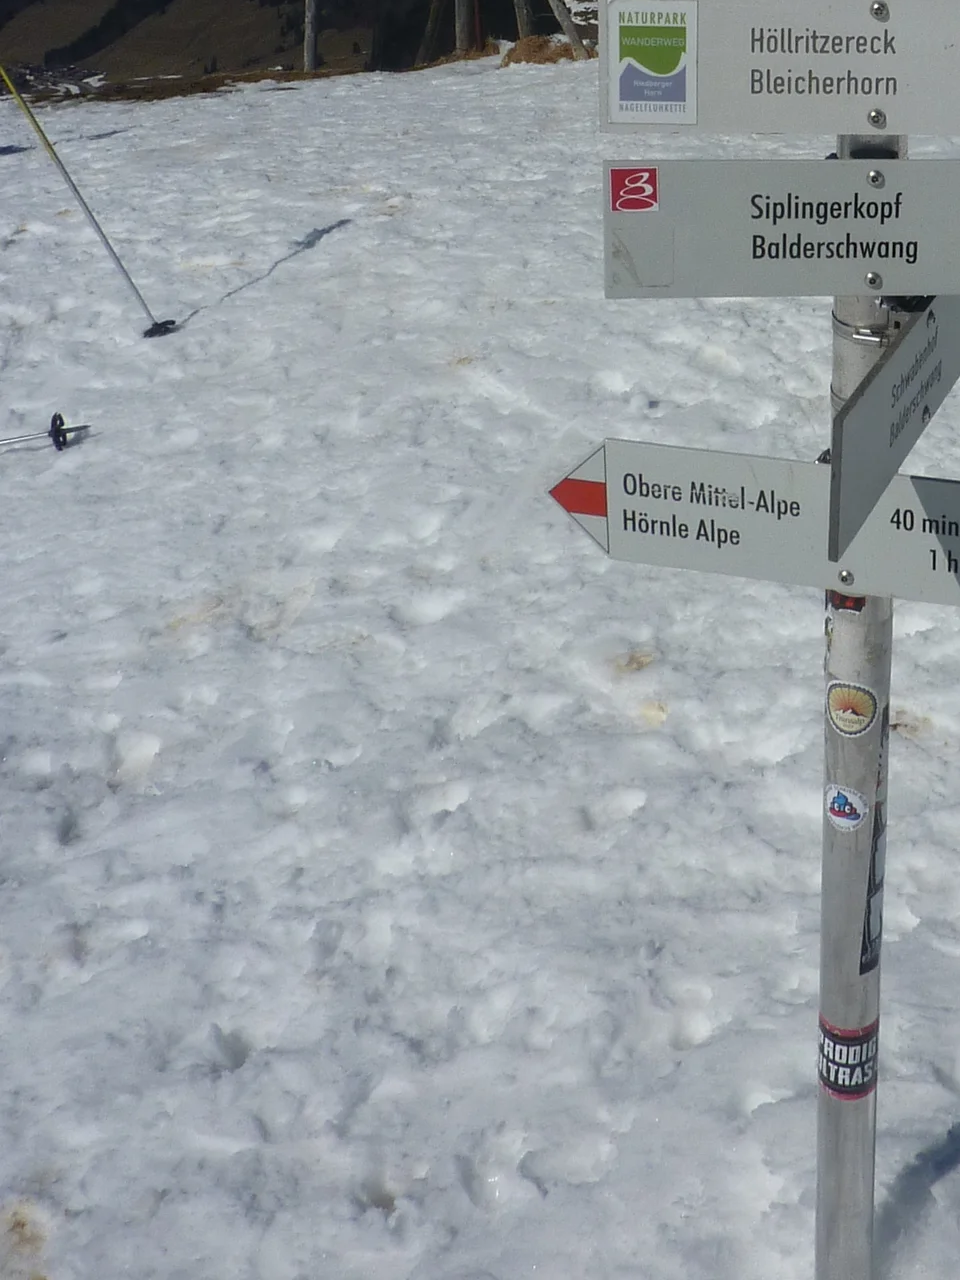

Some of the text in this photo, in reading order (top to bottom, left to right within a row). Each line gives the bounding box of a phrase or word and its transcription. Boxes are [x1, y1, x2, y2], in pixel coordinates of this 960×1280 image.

[618, 11, 687, 25] NATURPARK
[621, 36, 685, 47] WANDERWEG
[750, 28, 897, 54] Höllritzereck
[750, 68, 898, 95] Bleicherhorn
[618, 102, 687, 114] NAGELFLUHKETTE
[750, 192, 903, 225] Siplingerkopf
[752, 233, 919, 264] Balderschwang
[889, 358, 943, 448] Balderschwang
[622, 472, 683, 502] Obere
[623, 508, 741, 549] Hörnle Alpe
[889, 508, 960, 537] 40 min
[928, 549, 959, 574] 1 h
